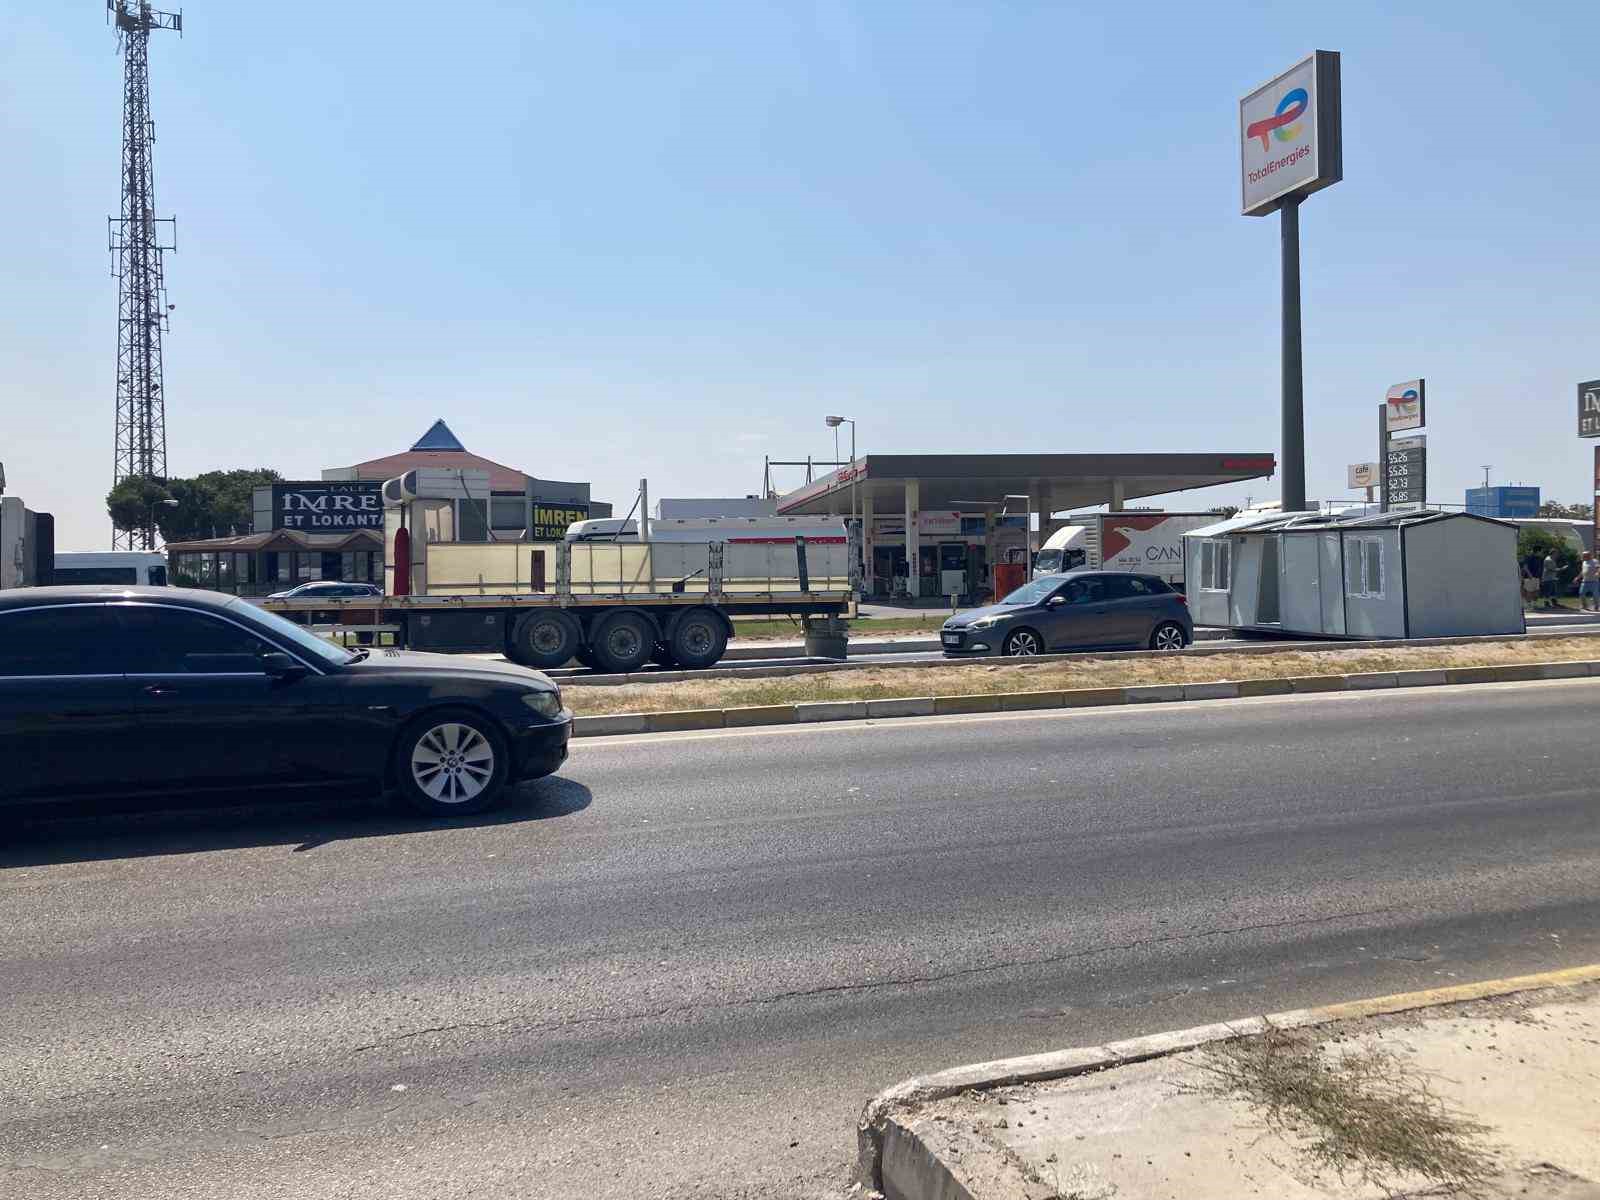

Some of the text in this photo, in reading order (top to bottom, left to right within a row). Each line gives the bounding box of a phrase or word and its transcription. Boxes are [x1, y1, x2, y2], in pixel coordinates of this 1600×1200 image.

[1248, 144, 1310, 184] TotalEnergies
[284, 515, 304, 526] ET
[534, 504, 588, 526] İMREN
[534, 526, 545, 537] ET
